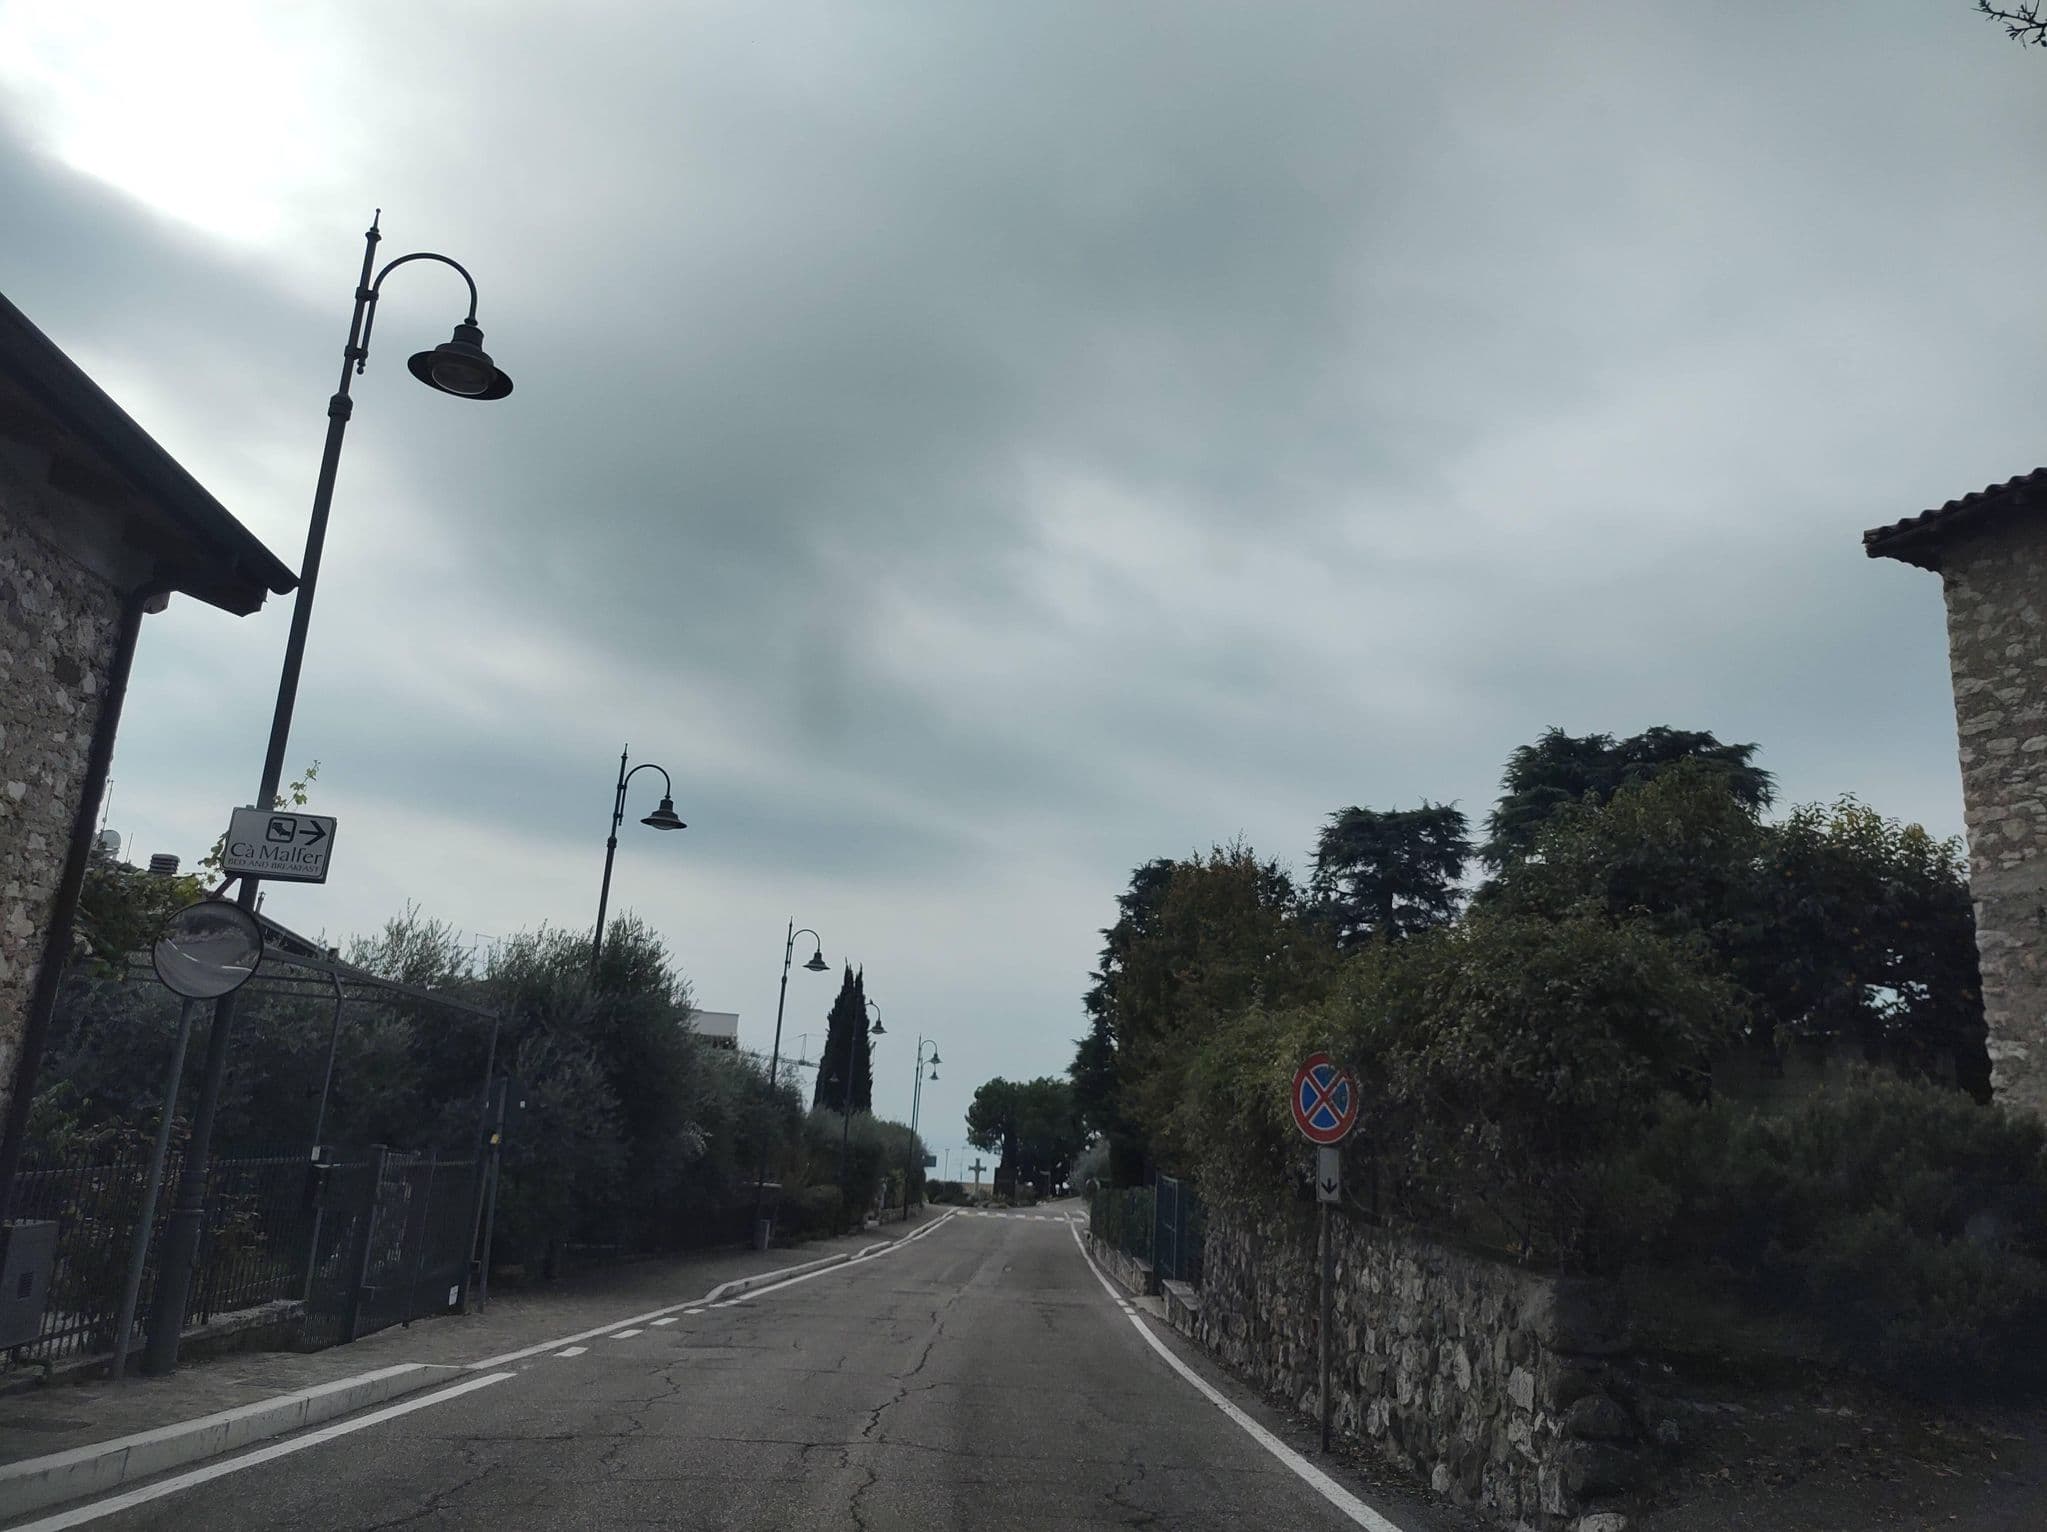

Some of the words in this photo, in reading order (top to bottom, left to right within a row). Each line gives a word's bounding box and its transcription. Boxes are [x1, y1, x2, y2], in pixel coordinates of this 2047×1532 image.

[259, 845, 323, 864] Malfer
[229, 857, 246, 865] BED
[250, 860, 269, 868] AND
[271, 862, 319, 873] BREAKFAST
